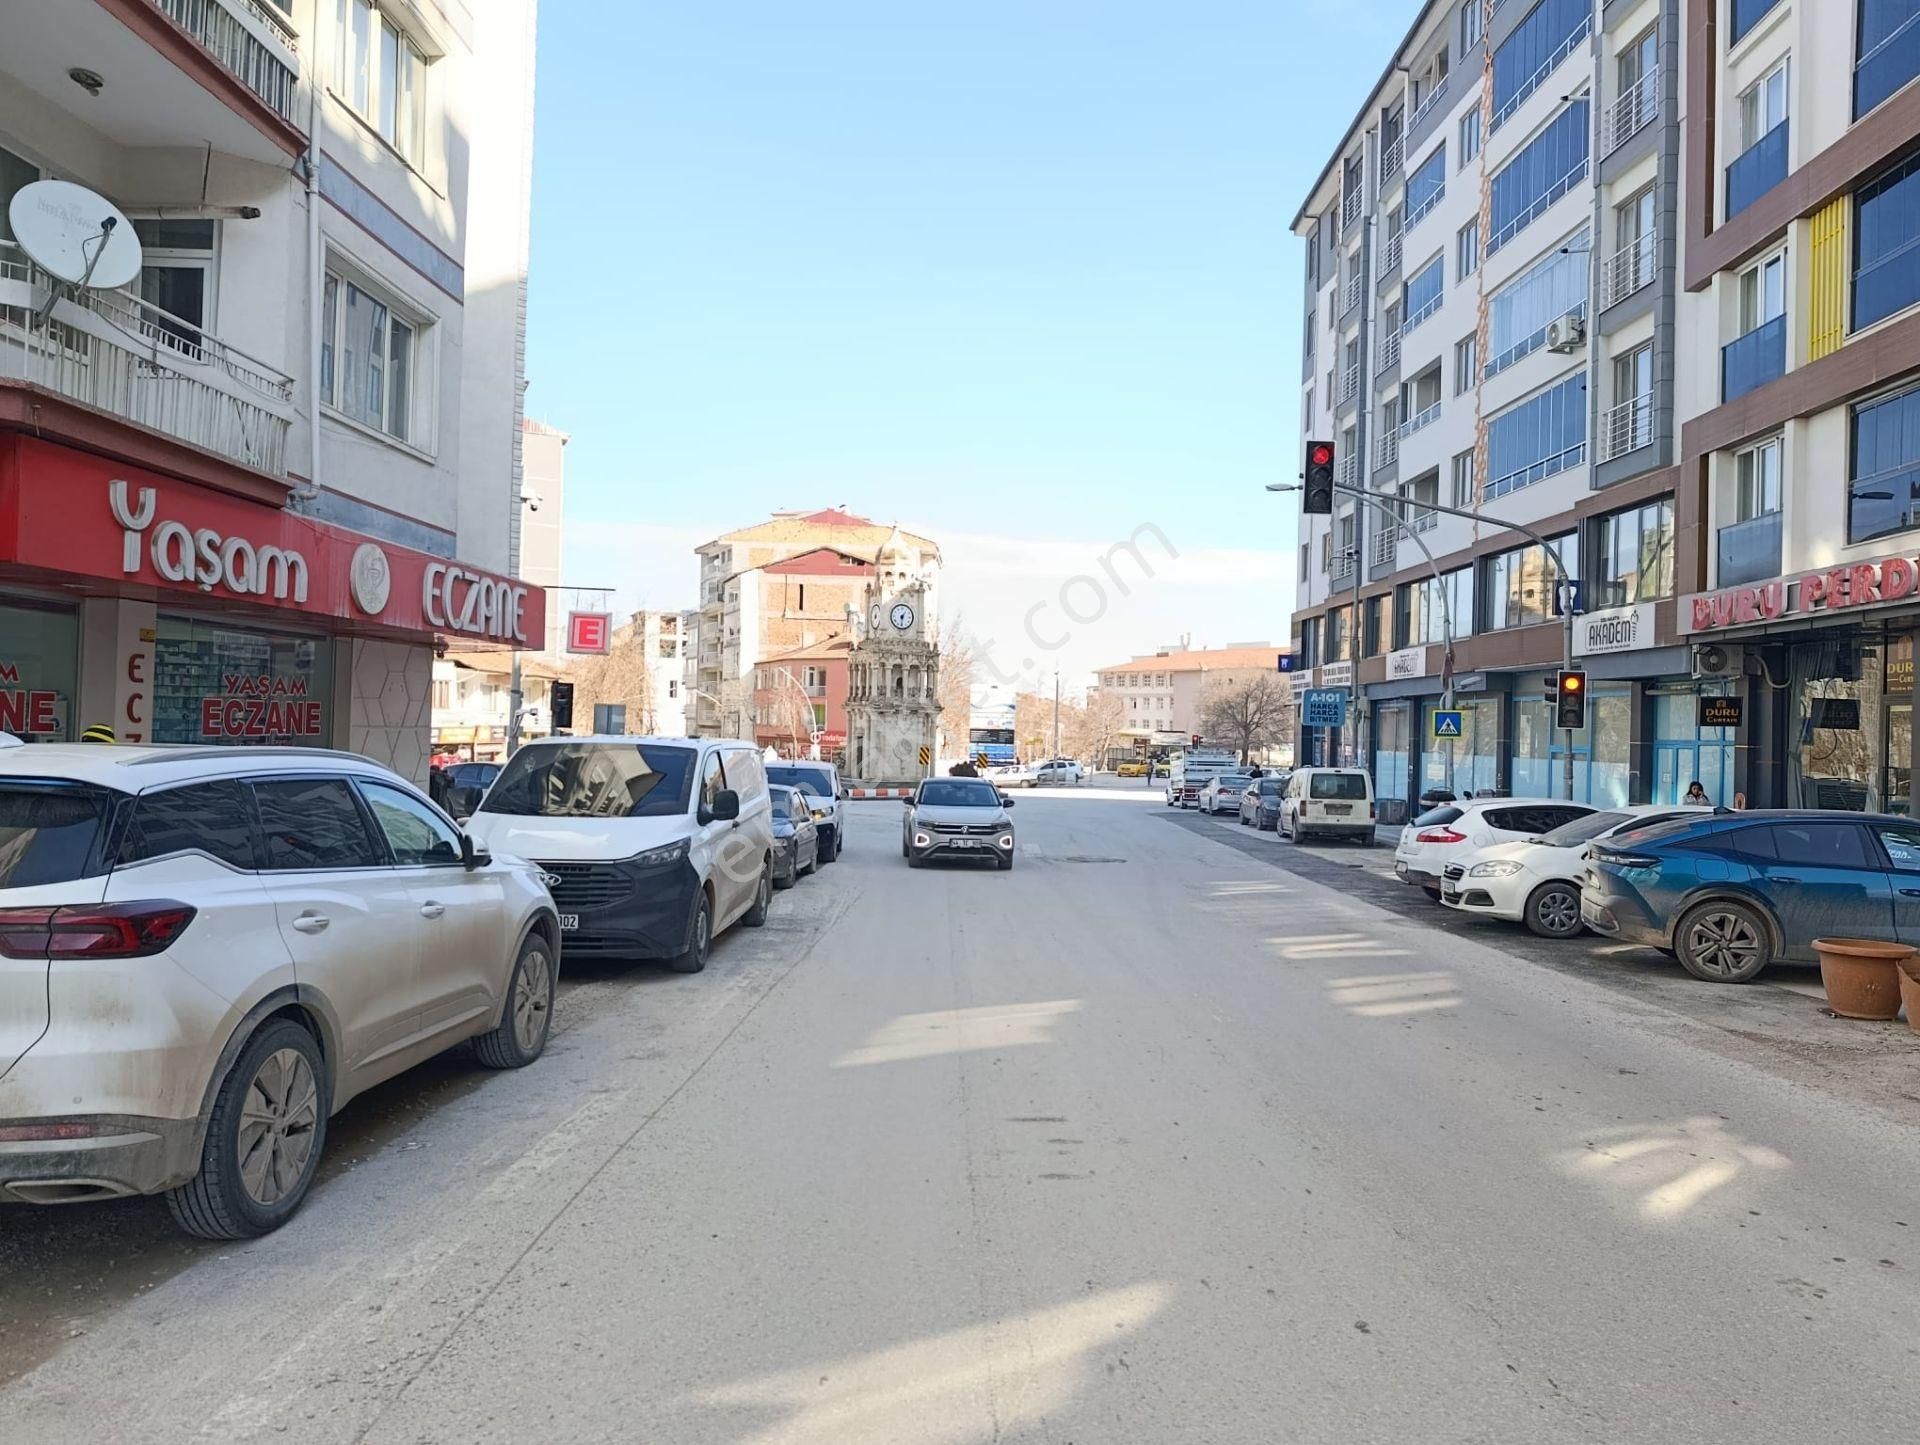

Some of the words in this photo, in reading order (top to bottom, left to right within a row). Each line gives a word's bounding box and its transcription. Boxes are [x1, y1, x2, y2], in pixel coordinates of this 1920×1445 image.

[423, 562, 527, 642] ECZANE
[1692, 582, 1785, 630] DURU
[1799, 556, 1920, 612] PERD
[223, 672, 308, 700] YAŞAM
[202, 698, 321, 737] ECZANE
[1705, 708, 1739, 716] DURU
